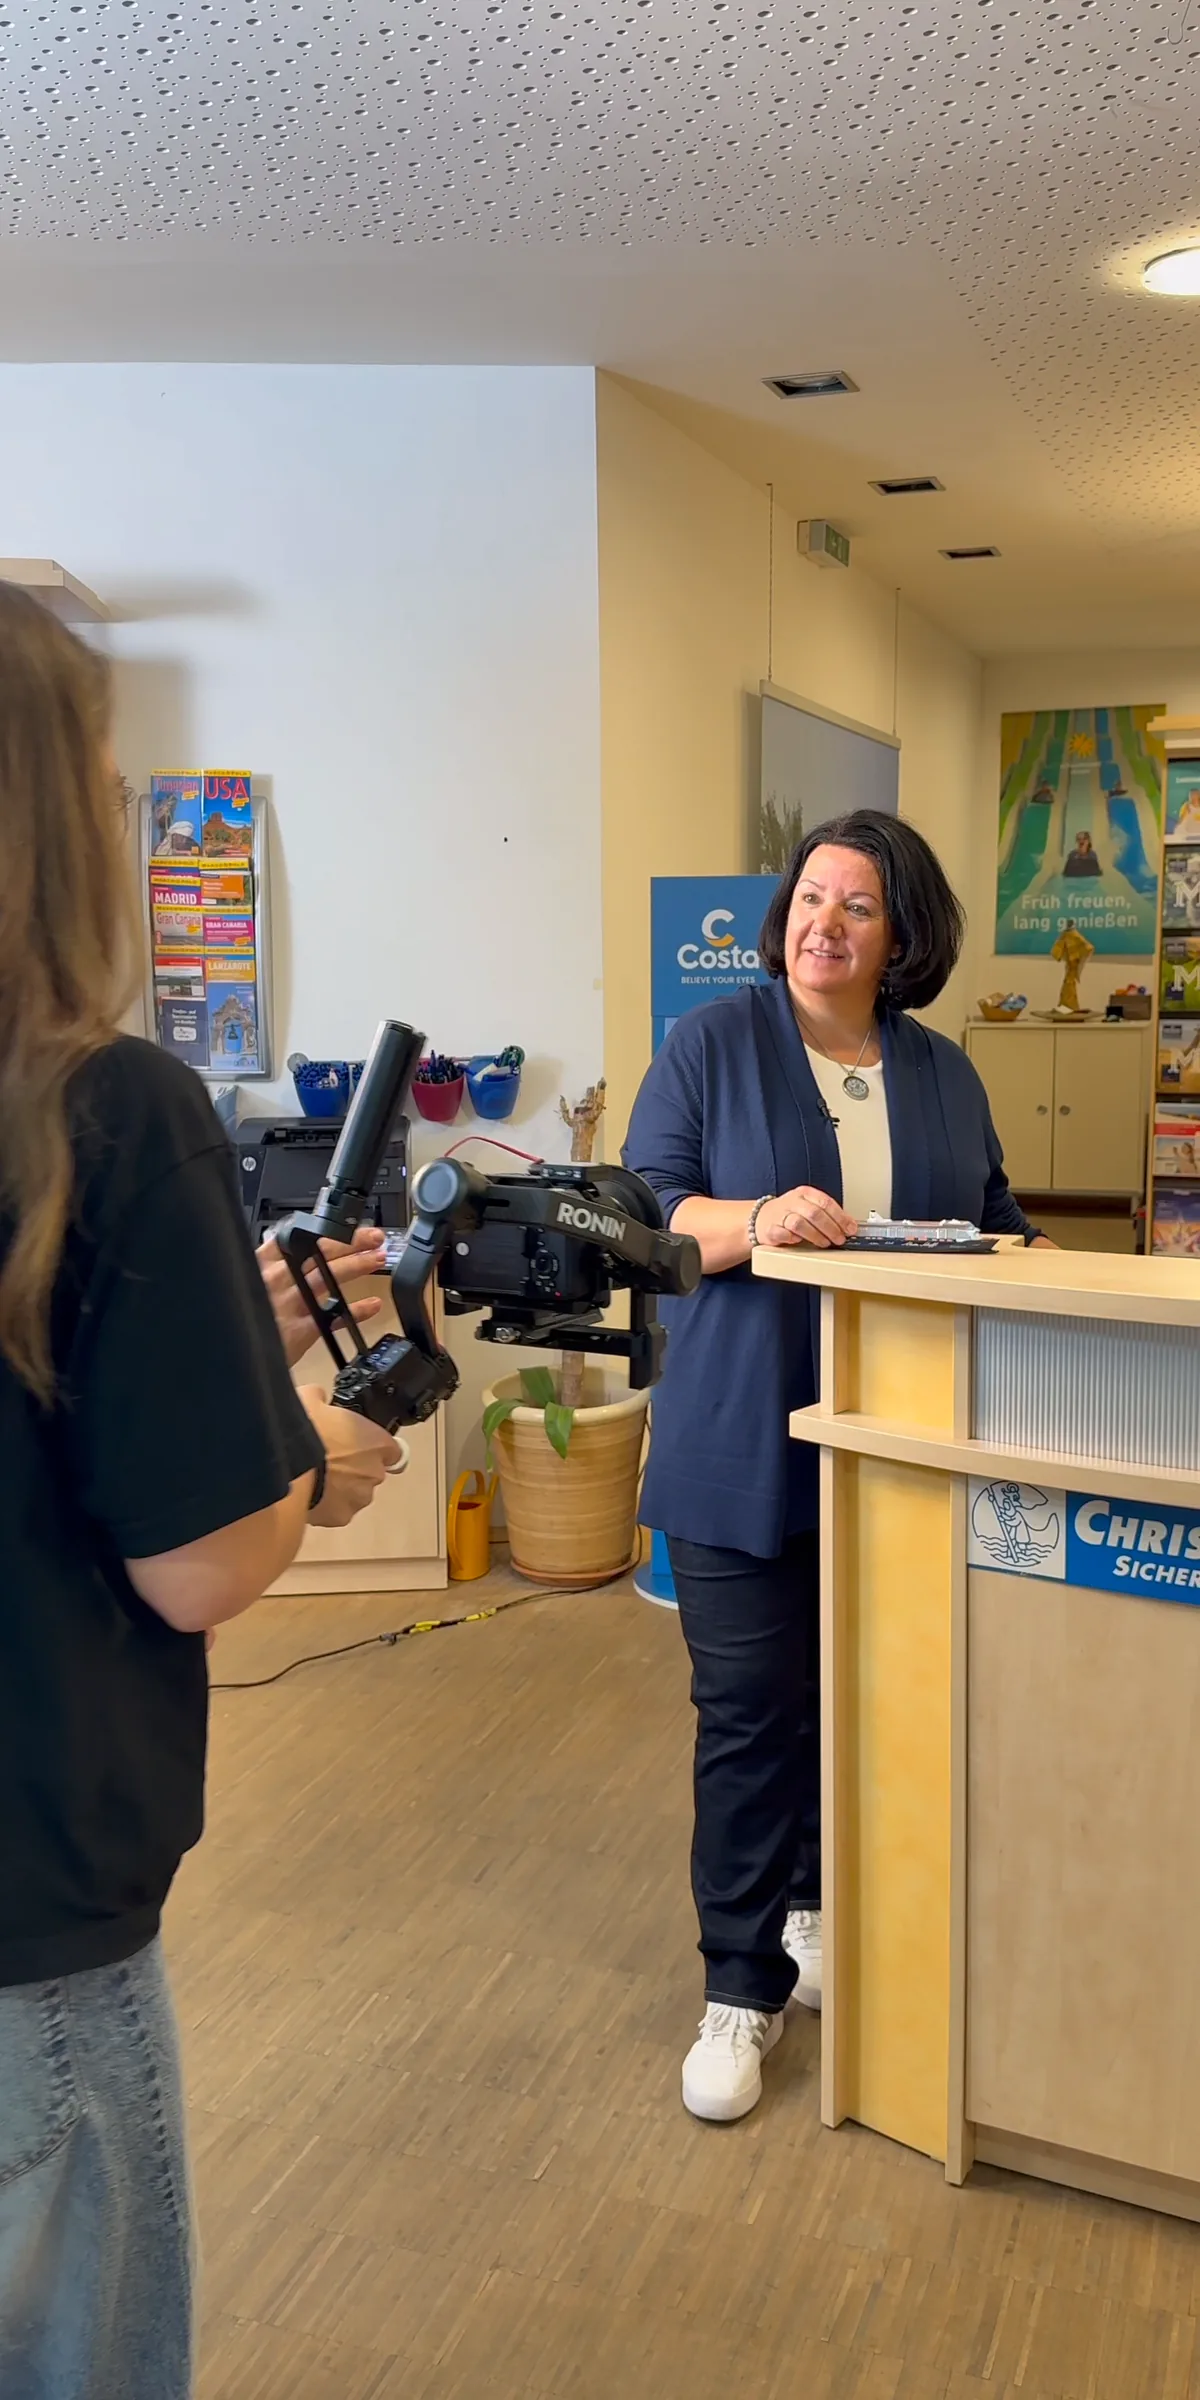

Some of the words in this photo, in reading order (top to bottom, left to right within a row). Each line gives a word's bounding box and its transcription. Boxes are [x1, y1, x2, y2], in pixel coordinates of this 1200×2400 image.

[205, 777, 248, 800] USA
[154, 891, 197, 905] MADRID
[1021, 895, 1061, 910] Früh
[1067, 893, 1132, 910] freuen,
[156, 912, 174, 925] Gran
[175, 912, 201, 926] Canaria
[205, 921, 221, 929] GRAN
[222, 921, 248, 929] CANARIA
[1013, 915, 1050, 932] lang
[677, 943, 760, 970] Costa
[208, 961, 251, 971] LANZAROTE
[681, 976, 711, 984] BELIEVE
[712, 976, 734, 984] YOUR
[736, 976, 756, 984] EYES
[556, 1203, 627, 1241] RONIN
[1074, 1499, 1200, 1561] CHRIS
[1112, 1555, 1200, 1589] SICHER
